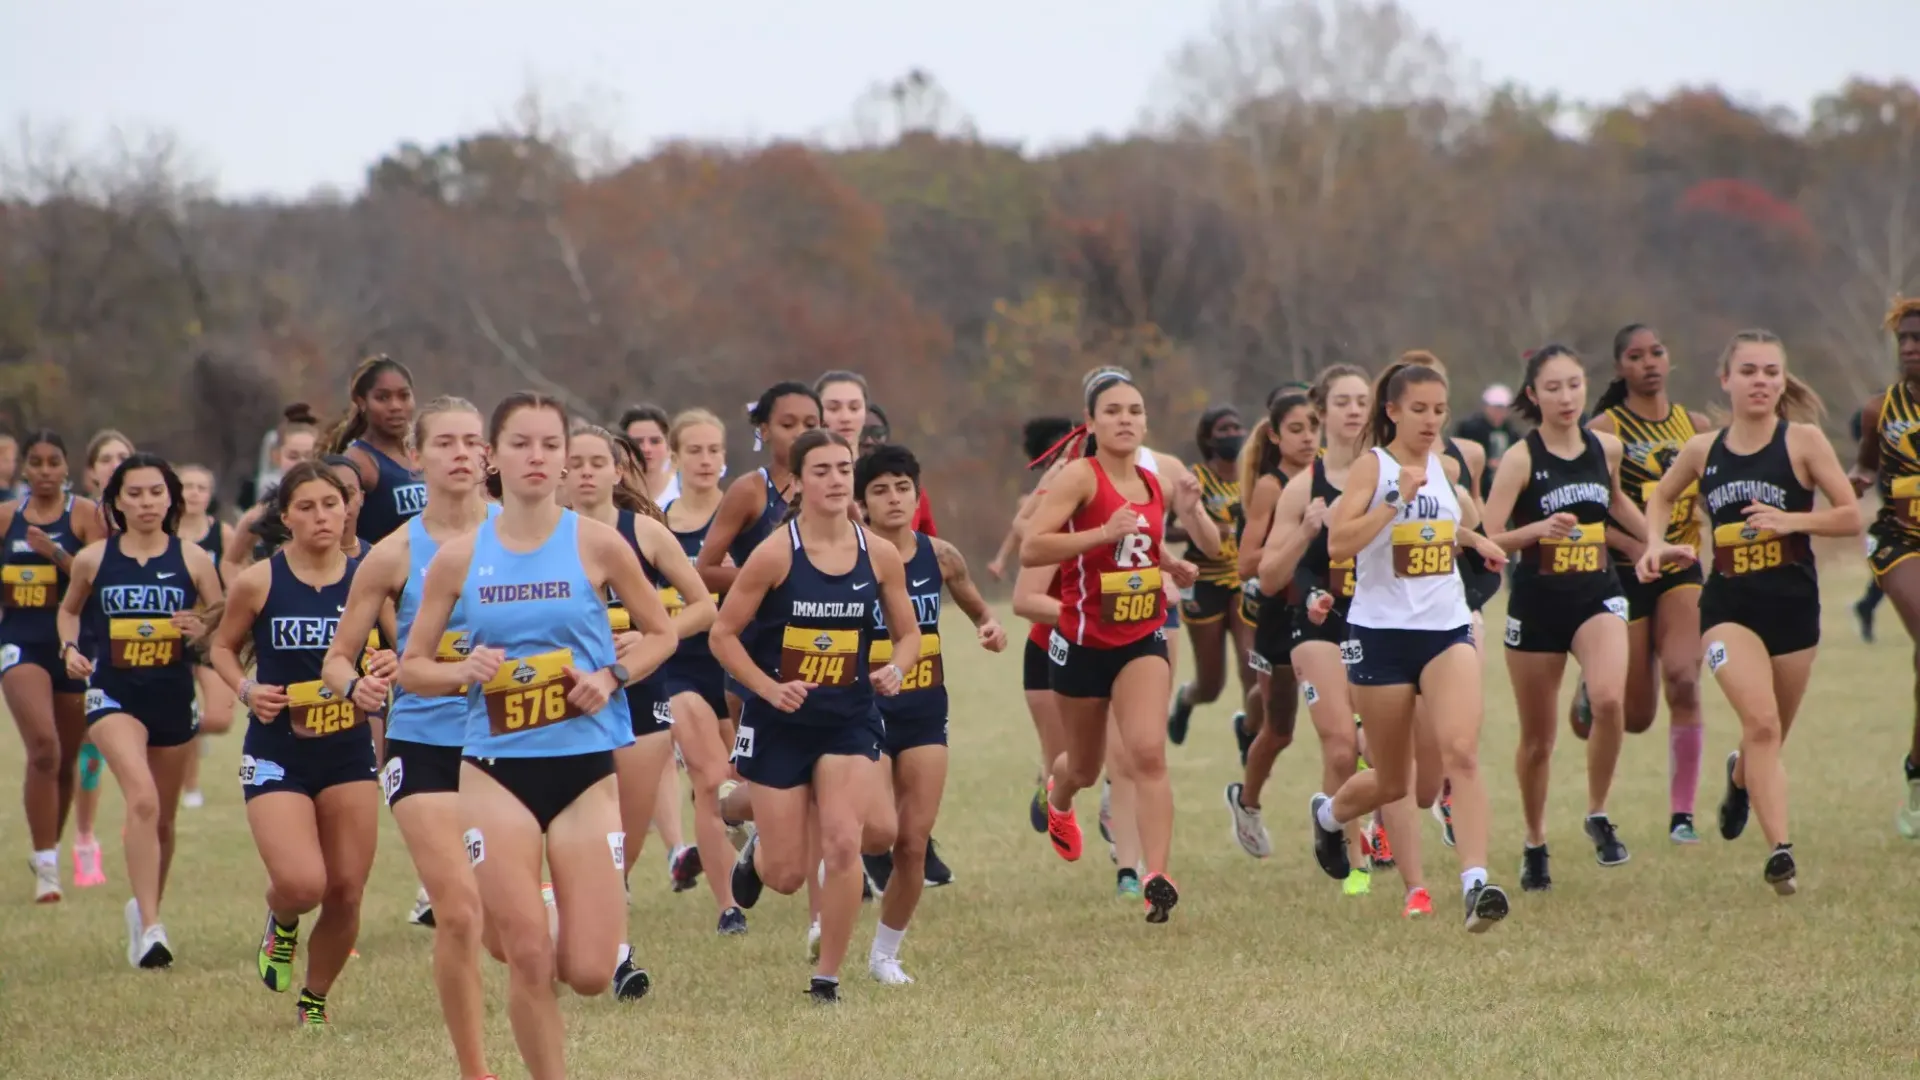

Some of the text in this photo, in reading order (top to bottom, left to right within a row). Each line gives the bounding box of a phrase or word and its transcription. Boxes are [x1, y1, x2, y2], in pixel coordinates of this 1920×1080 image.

[1707, 480, 1787, 515] SWARTHMORE
[1117, 533, 1153, 568] R
[1407, 545, 1452, 575] 392
[1552, 546, 1599, 573] 543
[1733, 541, 1782, 574] 539
[12, 584, 47, 608] 419
[101, 585, 185, 615] KEAN
[478, 581, 571, 604] WIDENER
[1113, 593, 1156, 622] 508
[123, 641, 173, 667] 424
[1051, 644, 1067, 661] 08
[798, 655, 845, 684] 414
[900, 660, 932, 690] 26
[305, 702, 355, 735] 429
[505, 683, 566, 730] 576
